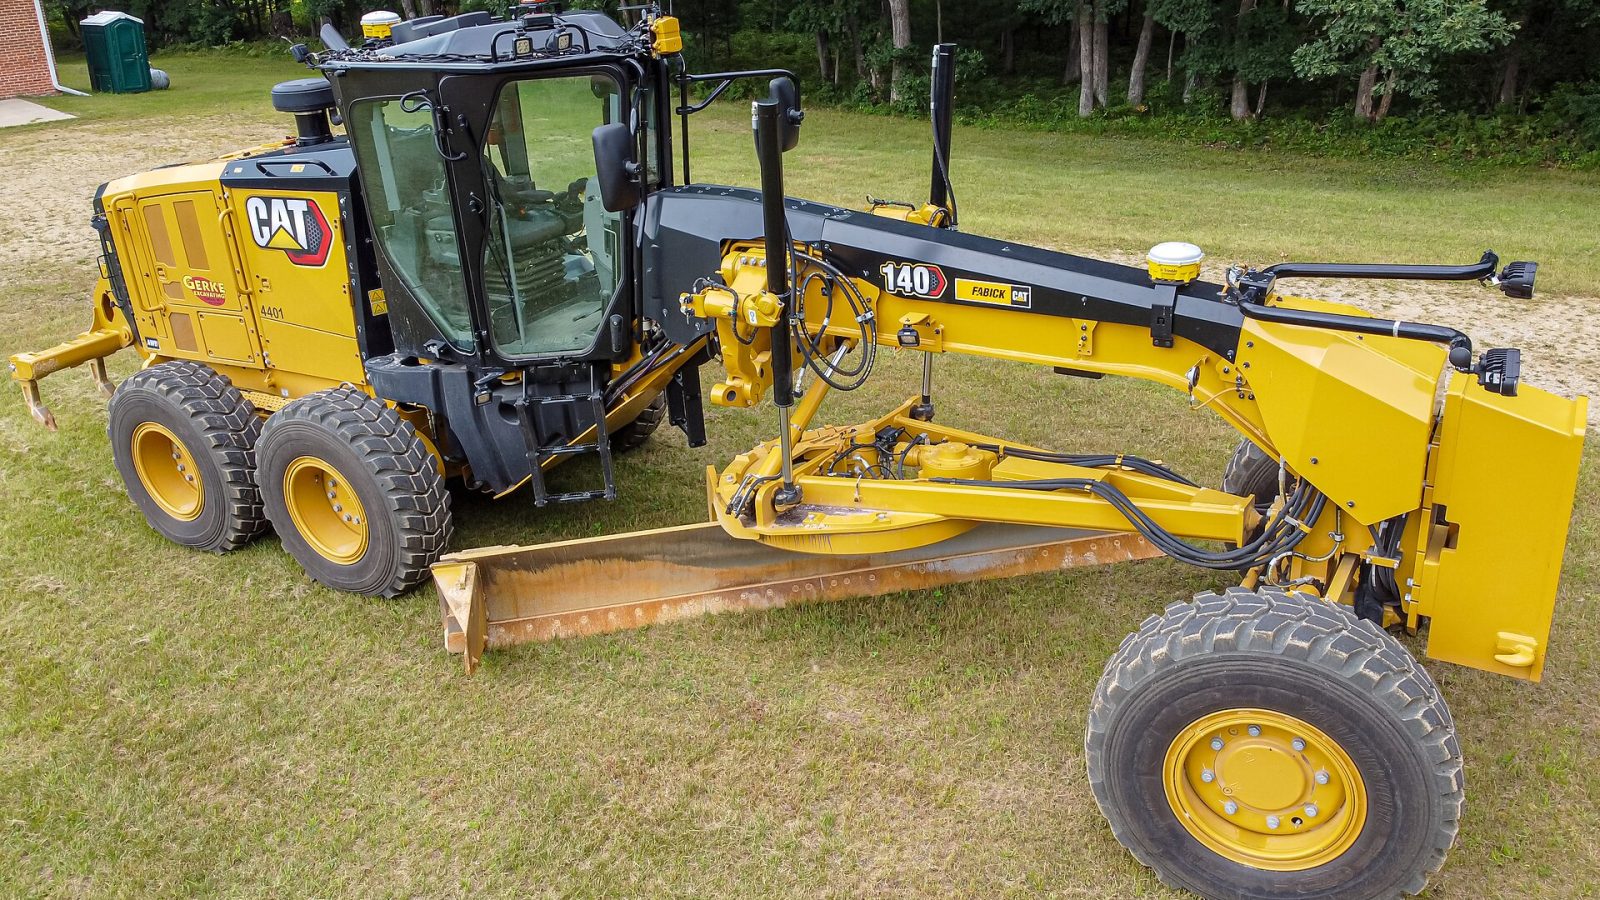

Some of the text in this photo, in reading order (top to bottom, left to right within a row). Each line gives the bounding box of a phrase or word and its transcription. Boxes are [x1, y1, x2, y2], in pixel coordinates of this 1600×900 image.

[246, 196, 309, 250] CAT
[183, 275, 226, 294] GERKE
[882, 263, 930, 295] 140
[971, 286, 1029, 303] FABICK CAT
[261, 305, 285, 319] 4401
